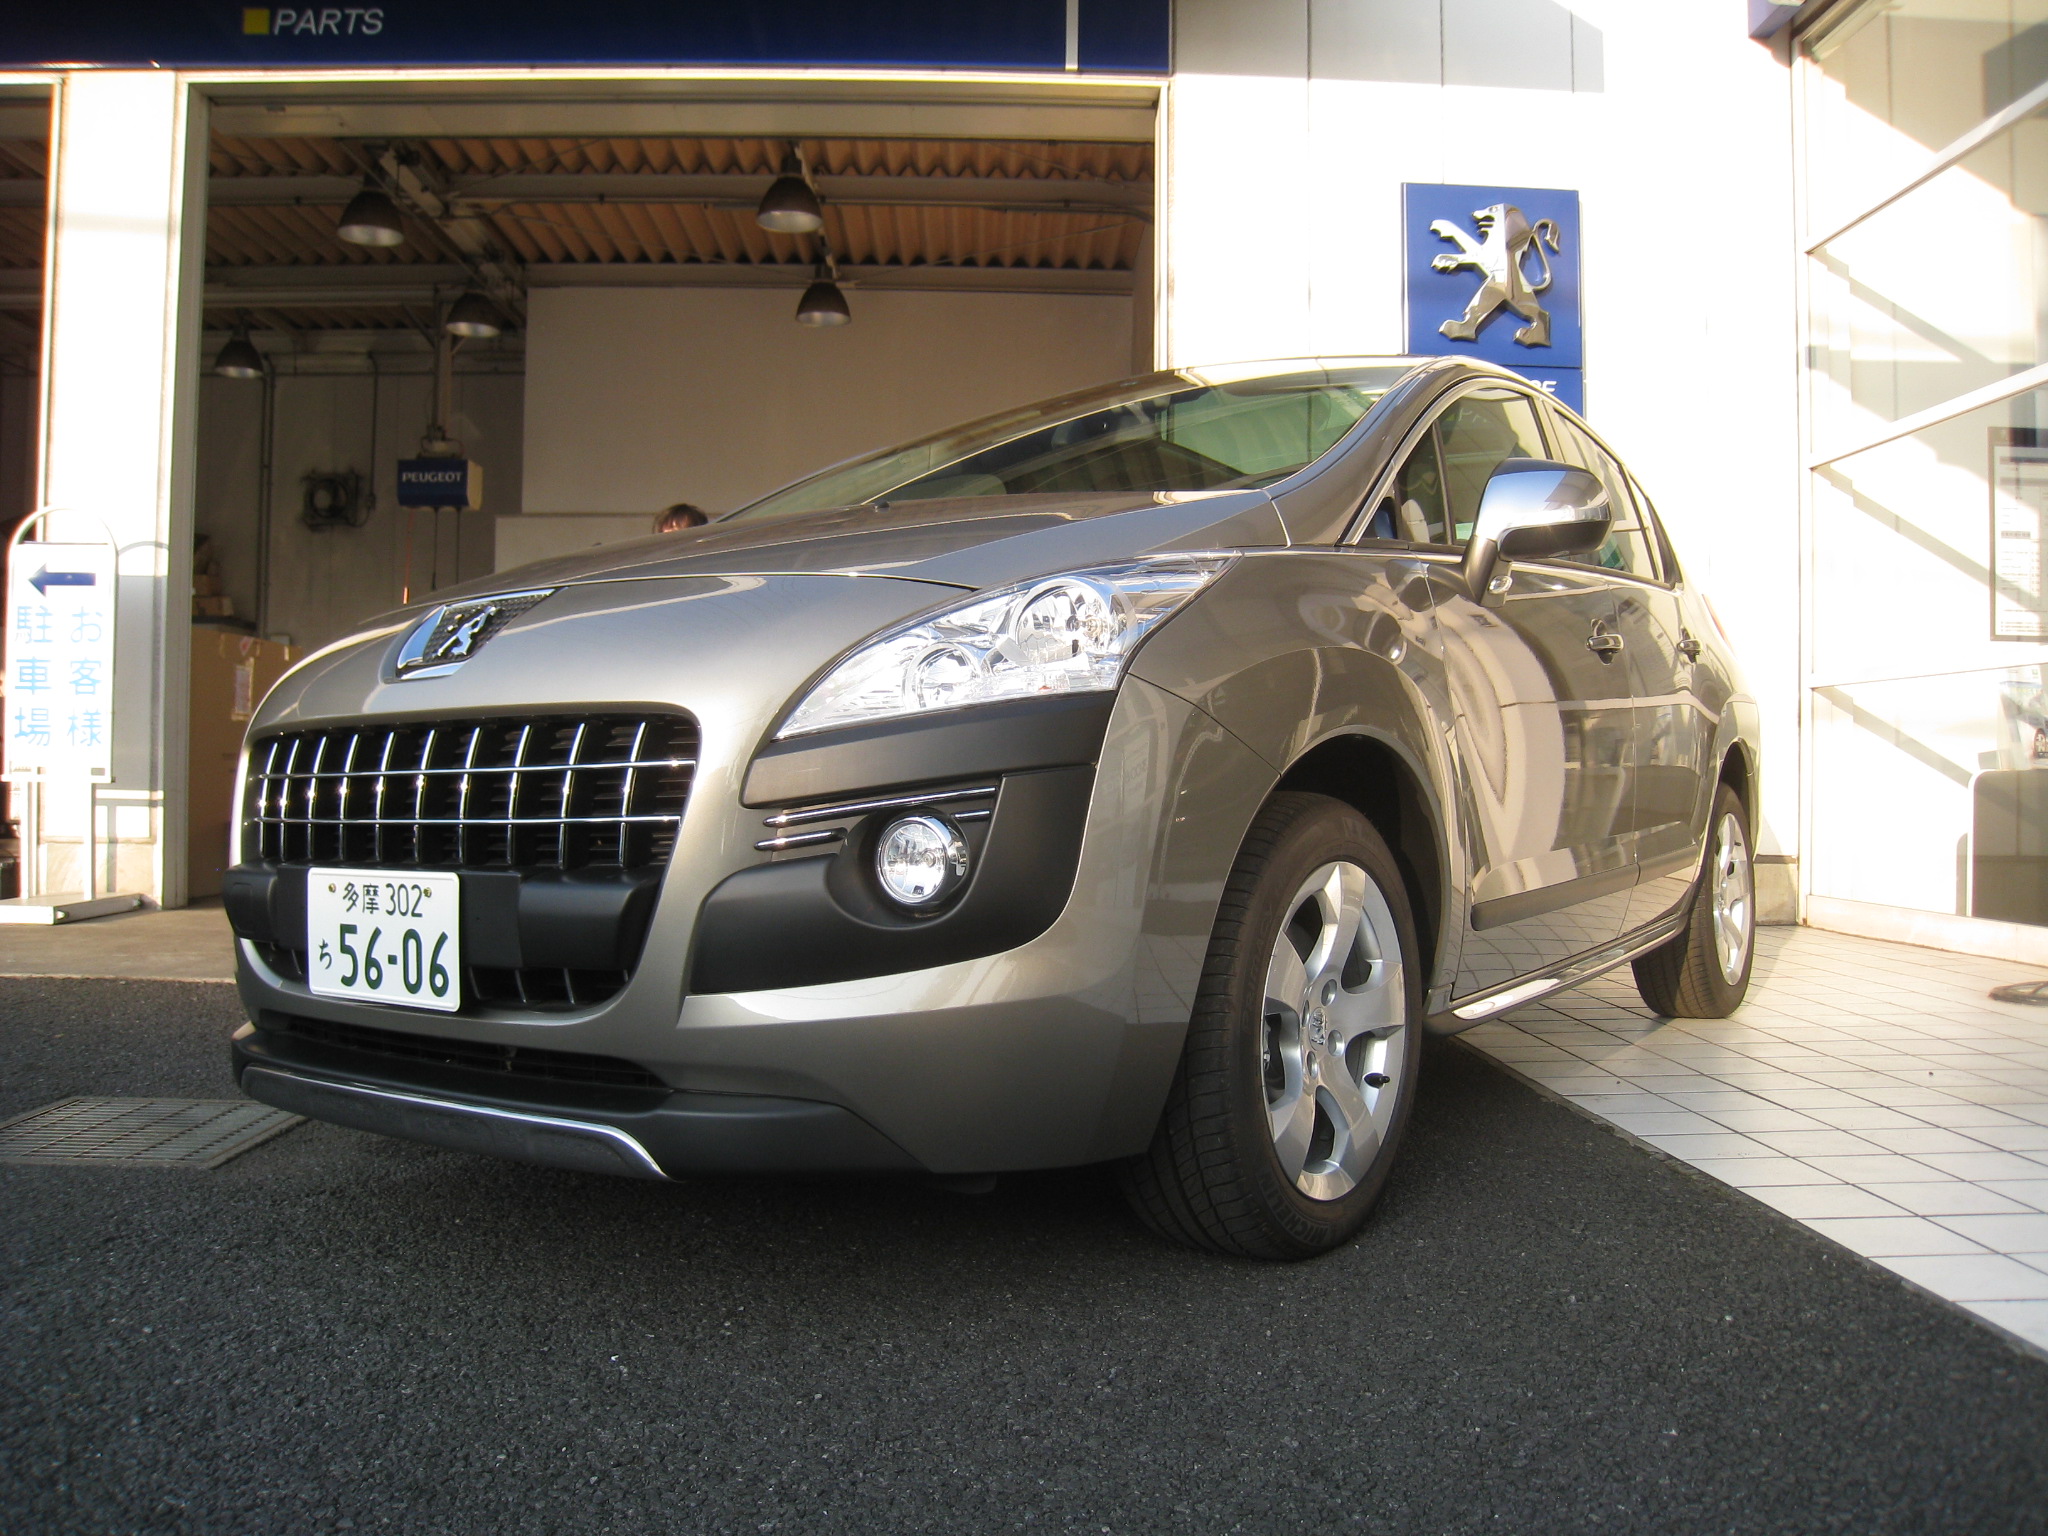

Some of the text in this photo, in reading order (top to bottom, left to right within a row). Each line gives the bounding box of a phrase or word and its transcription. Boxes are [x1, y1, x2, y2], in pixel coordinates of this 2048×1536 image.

[273, 8, 385, 36] PARTS
[401, 471, 463, 483] PEUGEOT
[14, 605, 54, 747] 駐車場
[67, 605, 104, 747] お客様
[385, 882, 423, 918] 302
[339, 923, 450, 998] 56-06
[1256, 1171, 1330, 1245] MICHELIN
